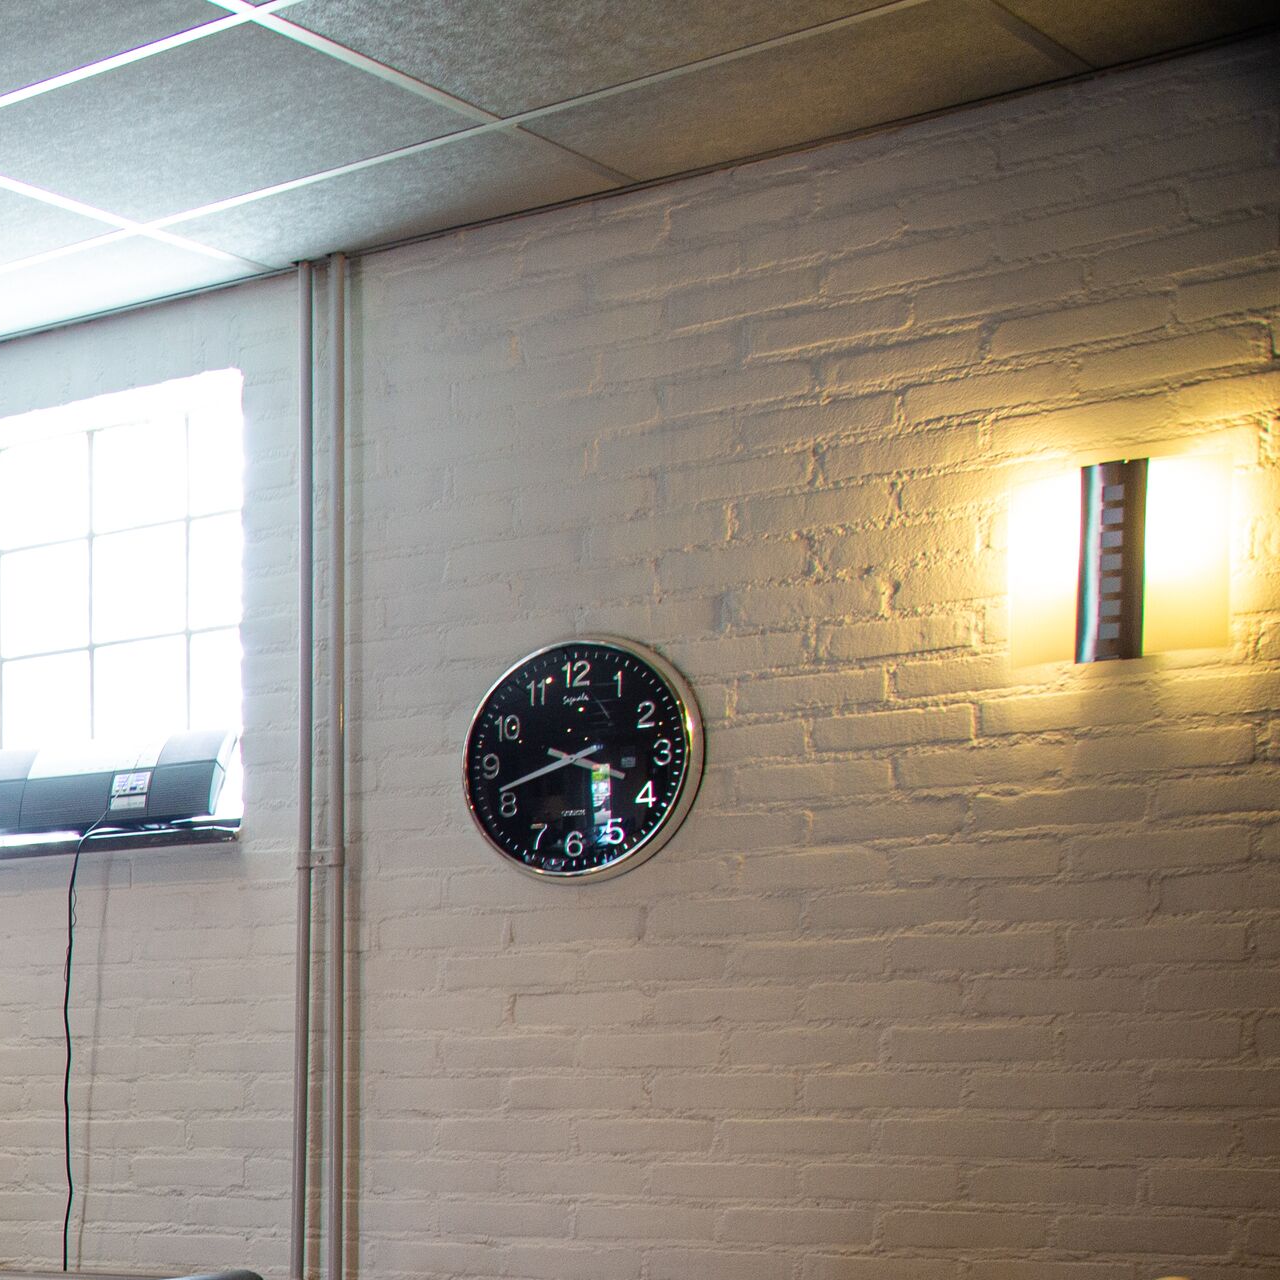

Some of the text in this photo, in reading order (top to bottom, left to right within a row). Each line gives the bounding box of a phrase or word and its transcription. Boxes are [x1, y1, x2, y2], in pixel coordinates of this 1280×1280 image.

[561, 660, 591, 689] 12
[613, 670, 623, 698] 1
[525, 678, 547, 707] 11
[494, 714, 521, 743] 10
[637, 701, 656, 729] 2
[653, 739, 672, 766] 3
[482, 753, 500, 780] 9
[500, 792, 518, 818] 8
[635, 780, 657, 808] 4
[530, 823, 548, 850] 7
[565, 831, 584, 857] 6
[606, 818, 625, 845] 5
